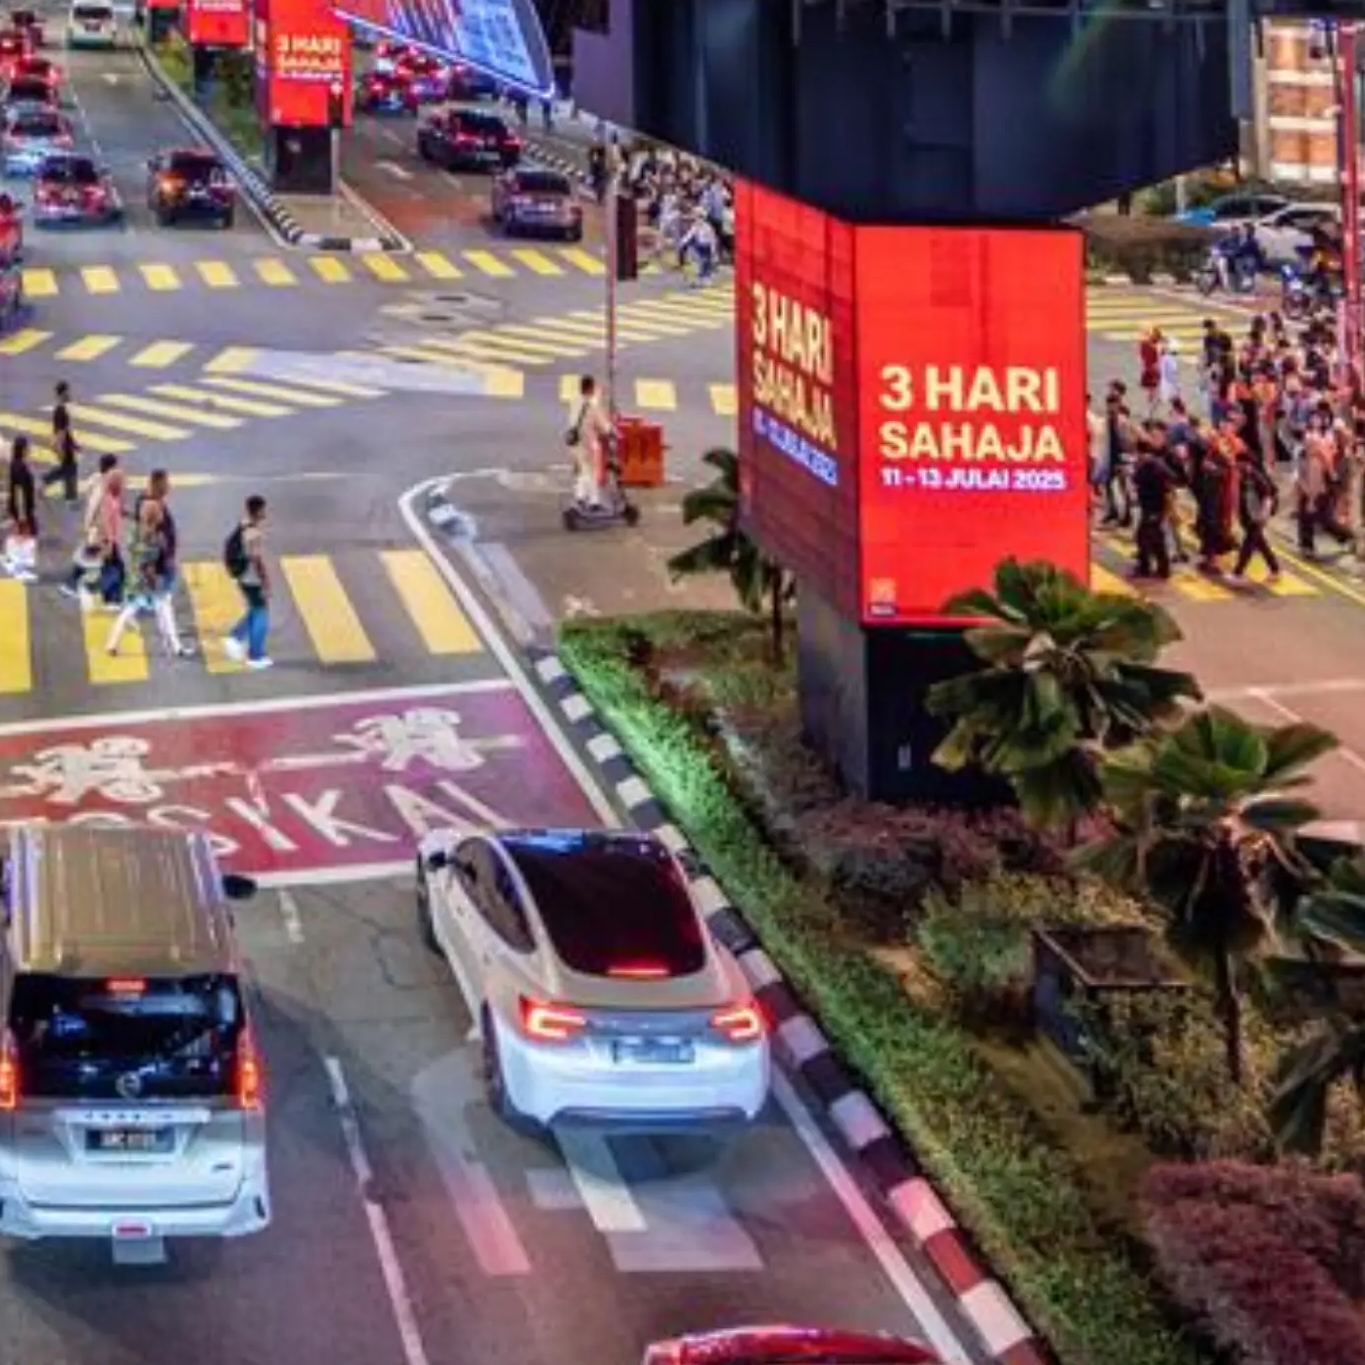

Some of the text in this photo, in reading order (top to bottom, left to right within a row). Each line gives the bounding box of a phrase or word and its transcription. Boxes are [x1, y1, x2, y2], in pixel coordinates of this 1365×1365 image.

[753, 281, 834, 385] 3 HARI
[879, 364, 1060, 414] 3 HARI
[878, 420, 1065, 462] SAHAJA
[944, 467, 1009, 490] JULAI
